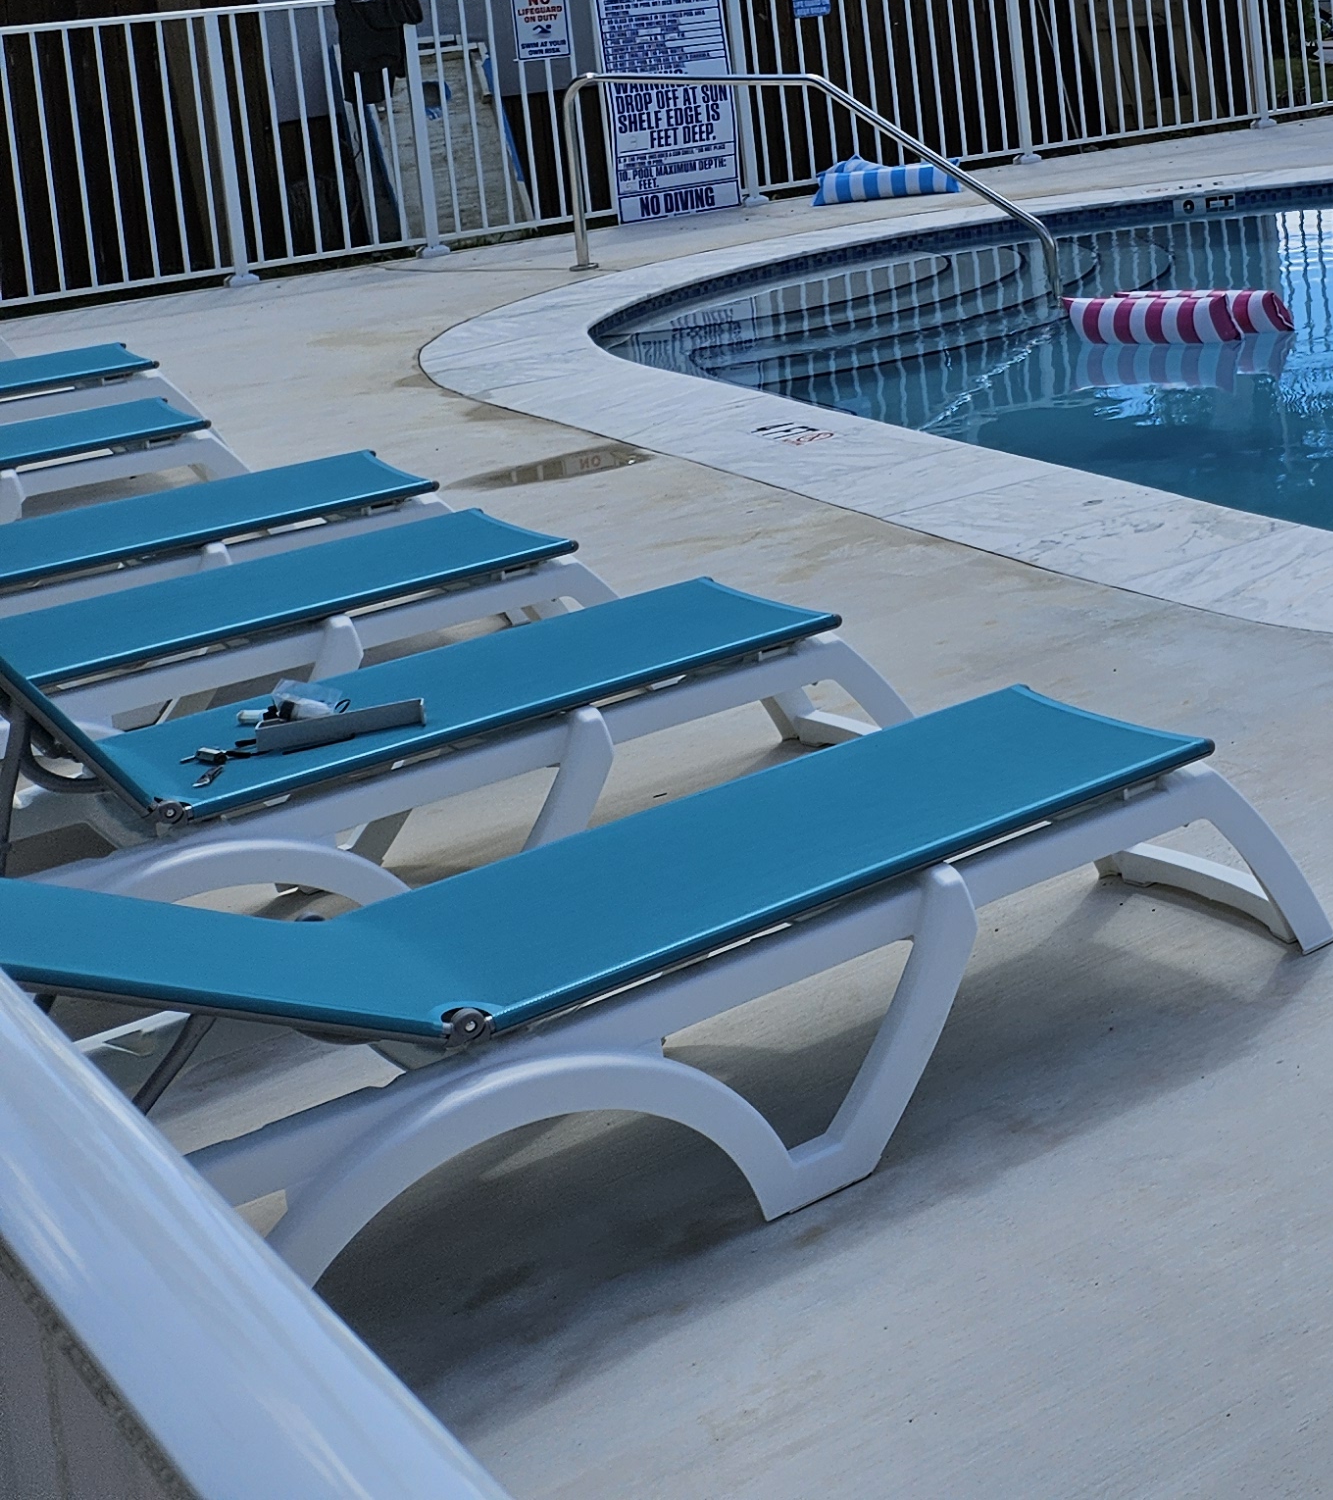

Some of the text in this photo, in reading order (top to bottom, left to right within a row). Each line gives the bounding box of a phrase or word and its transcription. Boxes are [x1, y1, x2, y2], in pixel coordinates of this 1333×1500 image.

[518, 6, 562, 16] LIFEGUARD
[538, 14, 557, 22] DUTY
[616, 84, 728, 114] DROP OFF AT SUN
[618, 103, 720, 134] SHELF EDGE IS
[650, 122, 716, 149] FEET DEEP.
[620, 171, 631, 182] 10.
[633, 166, 653, 180] POOL
[656, 160, 696, 177] MAXIMUM
[698, 157, 727, 170] DEPTH:
[639, 178, 659, 190] FEET.
[639, 187, 715, 217] NO DIVING
